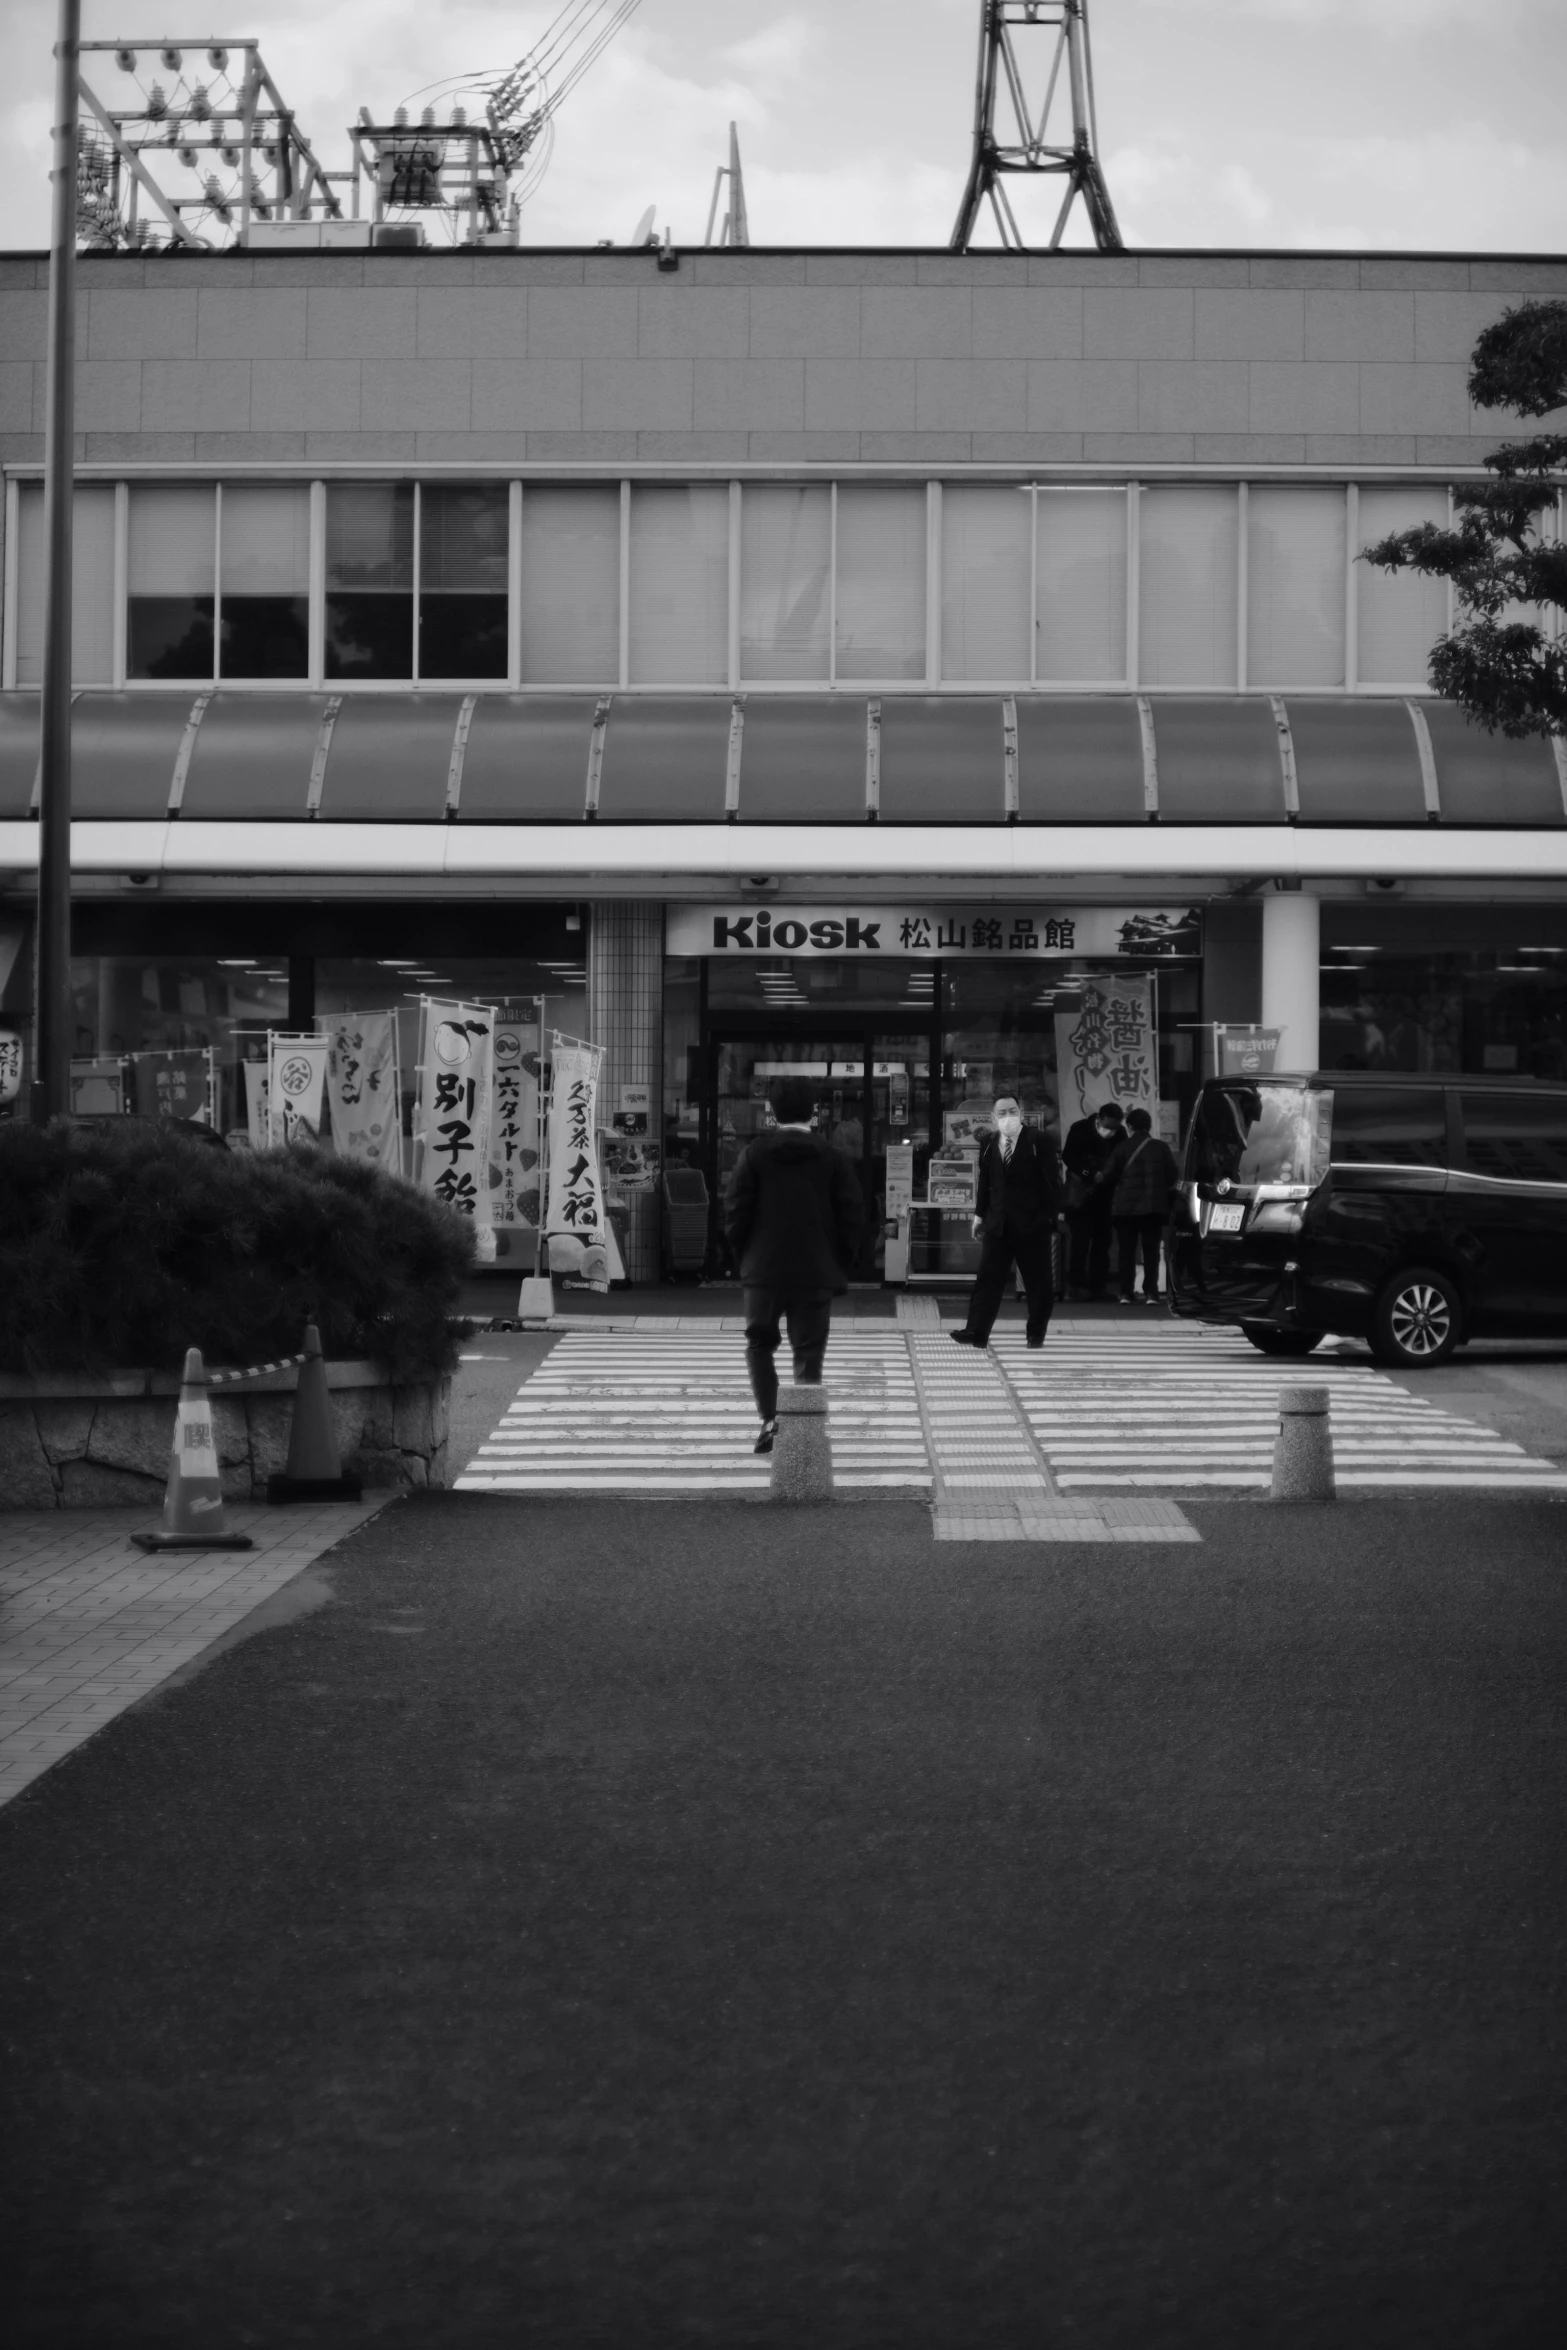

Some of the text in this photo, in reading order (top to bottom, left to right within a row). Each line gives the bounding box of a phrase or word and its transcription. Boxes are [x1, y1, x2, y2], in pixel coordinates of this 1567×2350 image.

[713, 910, 1076, 951] Kiosk 松山銘品館
[433, 1072, 478, 1215] 別子飴
[497, 1064, 521, 1162] 一六タルト
[562, 1079, 598, 1228] 久万茶大福
